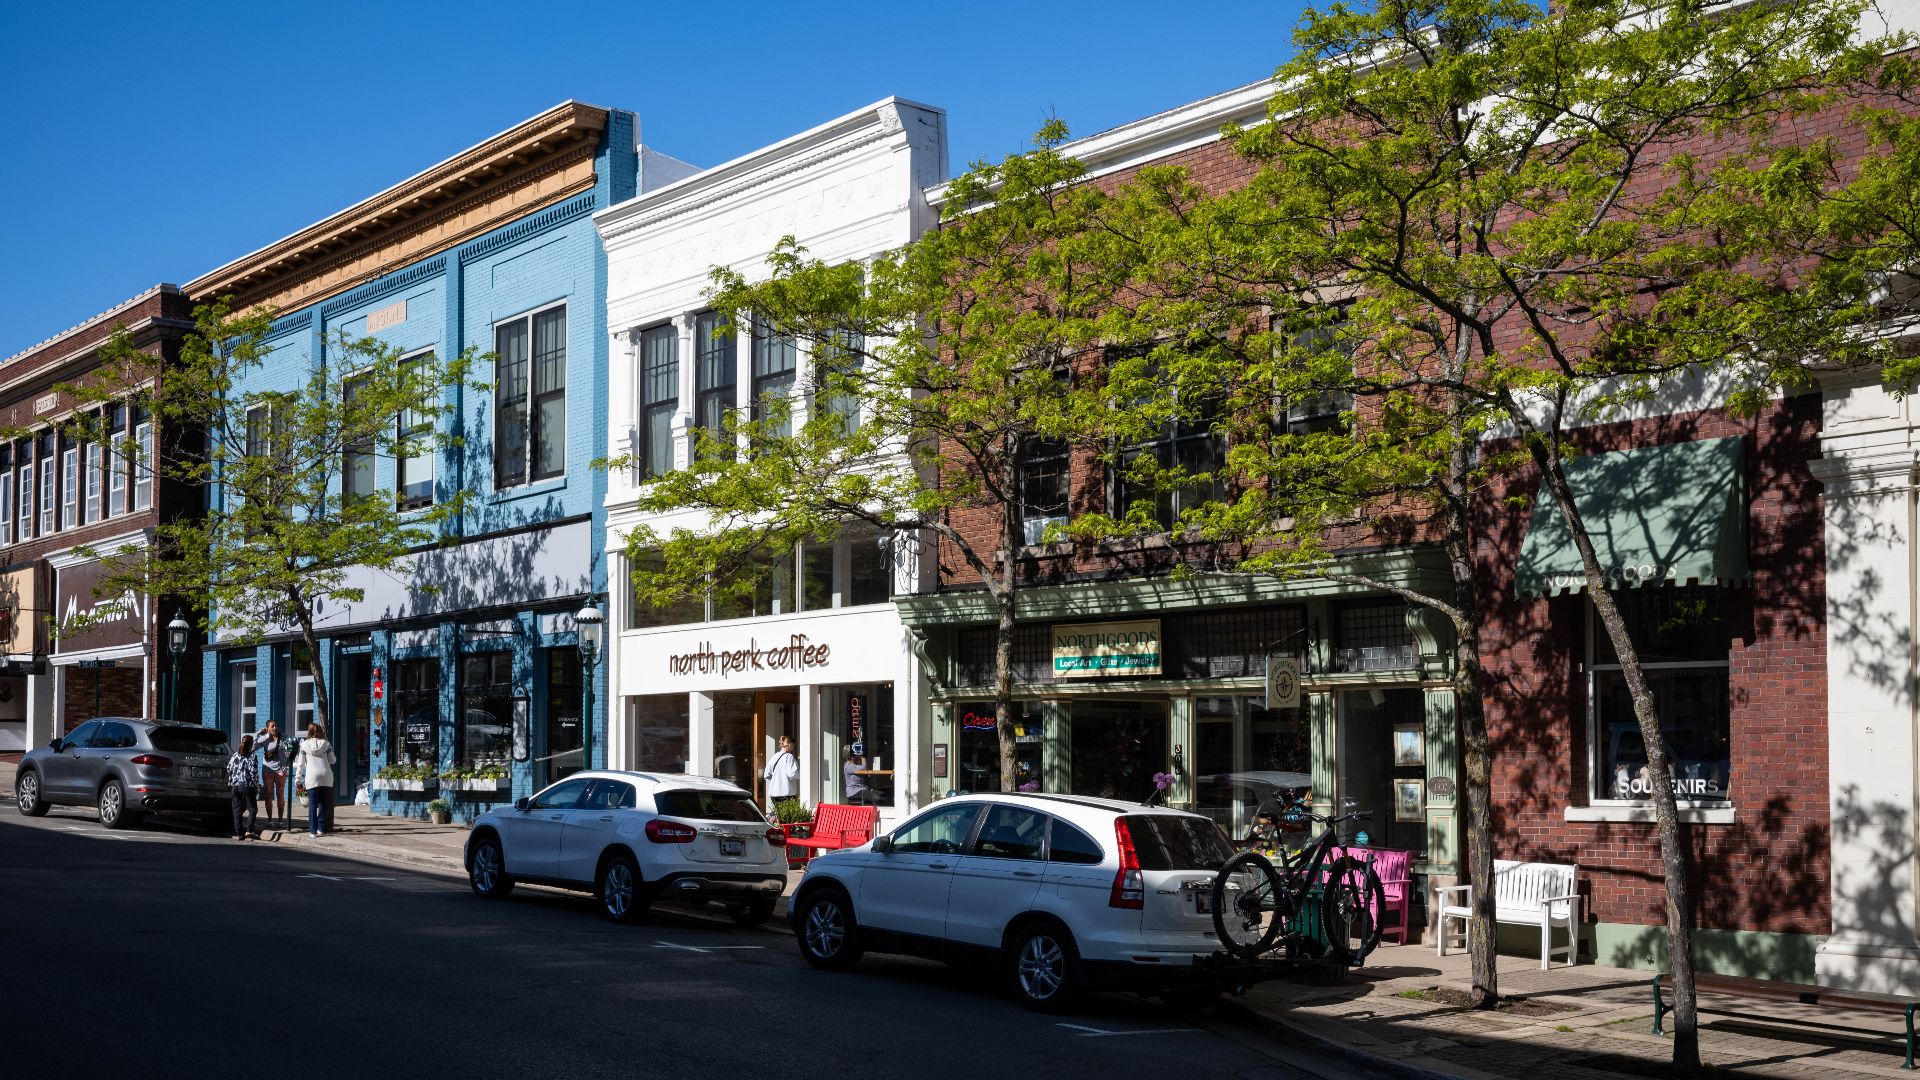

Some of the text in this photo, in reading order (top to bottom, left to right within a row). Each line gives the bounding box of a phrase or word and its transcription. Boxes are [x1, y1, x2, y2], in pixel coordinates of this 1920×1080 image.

[1056, 631, 1157, 649] NORTHGOODS
[669, 633, 829, 677] north perk coffee
[1059, 656, 1155, 668] Local Art Gifts Jewelry
[851, 697, 860, 738] OPEN
[963, 712, 996, 728] Open
[1619, 778, 1719, 794] SOUENIRS
